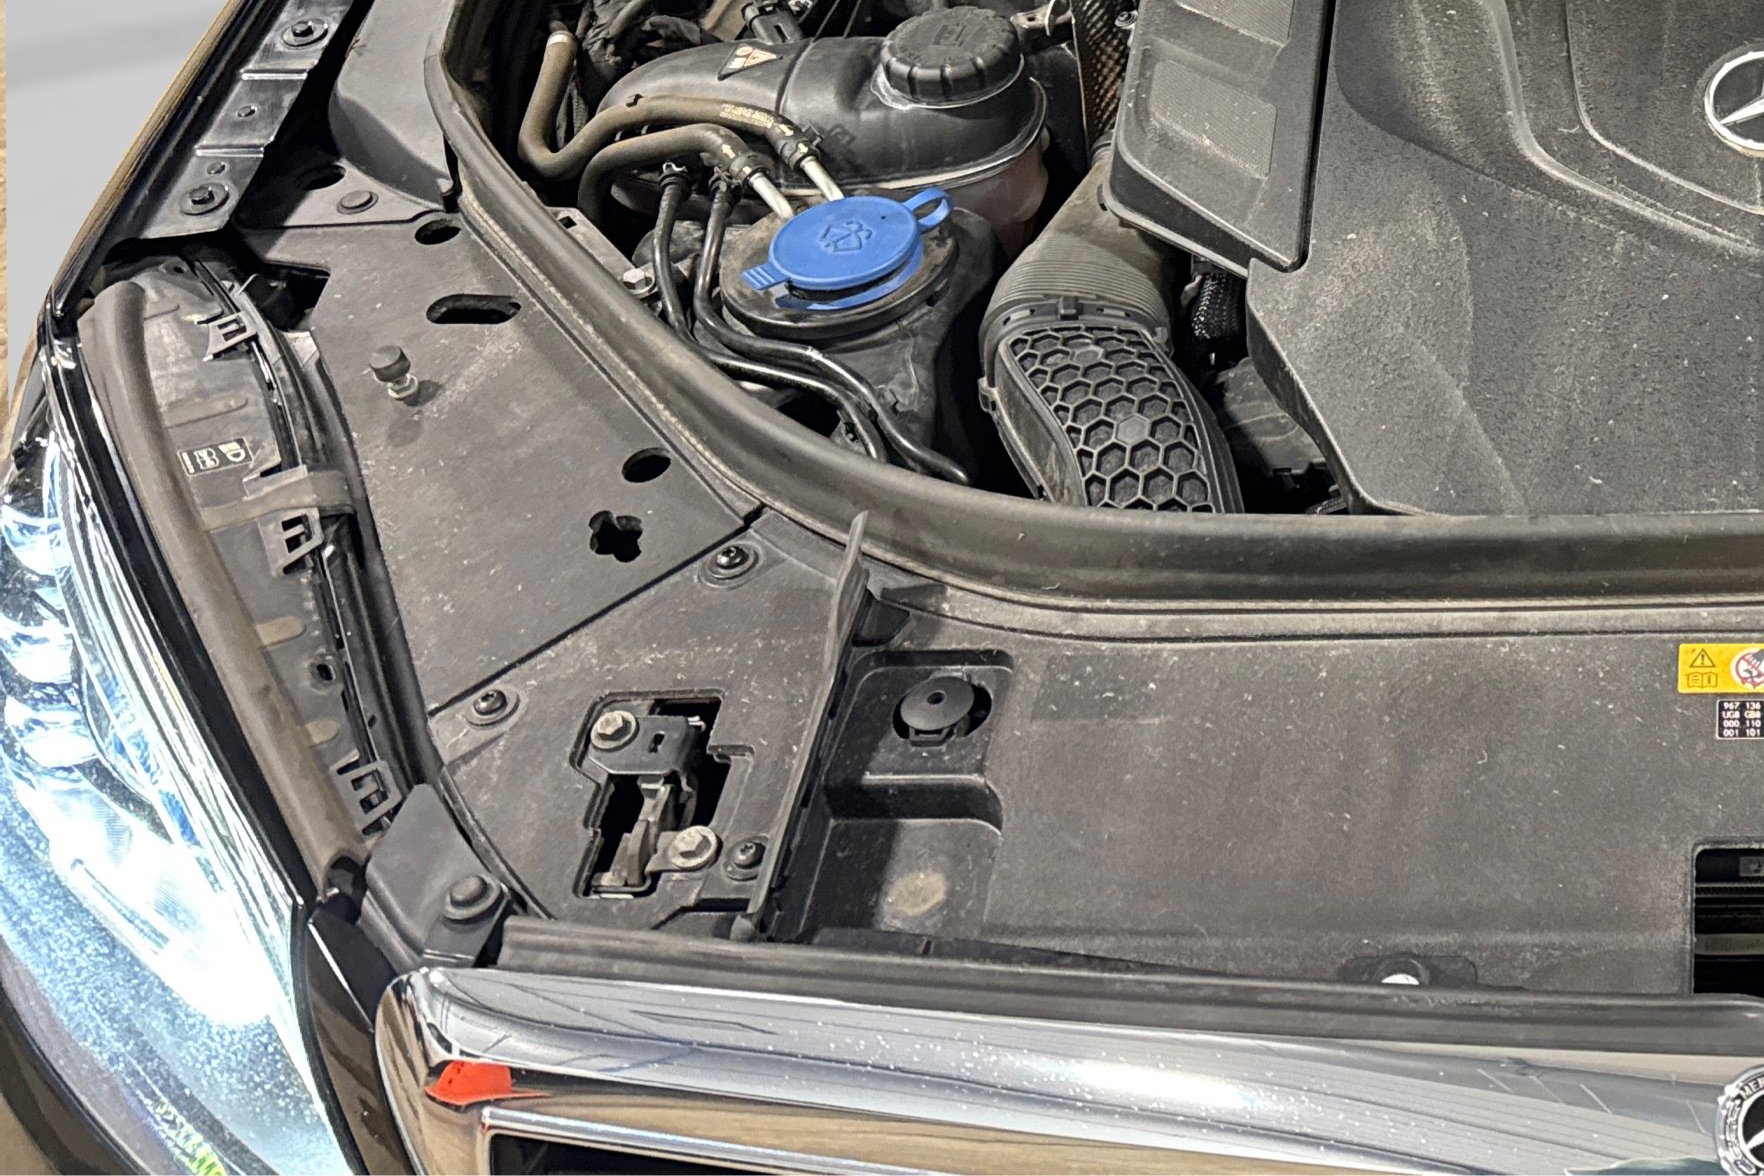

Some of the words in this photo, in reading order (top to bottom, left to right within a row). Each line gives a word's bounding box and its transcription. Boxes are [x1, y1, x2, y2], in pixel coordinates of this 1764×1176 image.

[1723, 701, 1740, 709] 967
[1746, 701, 1761, 709] 136
[1723, 719, 1740, 727] 000
[1746, 719, 1761, 727] 110
[1723, 728, 1739, 736] 001
[1746, 728, 1760, 736] 101
